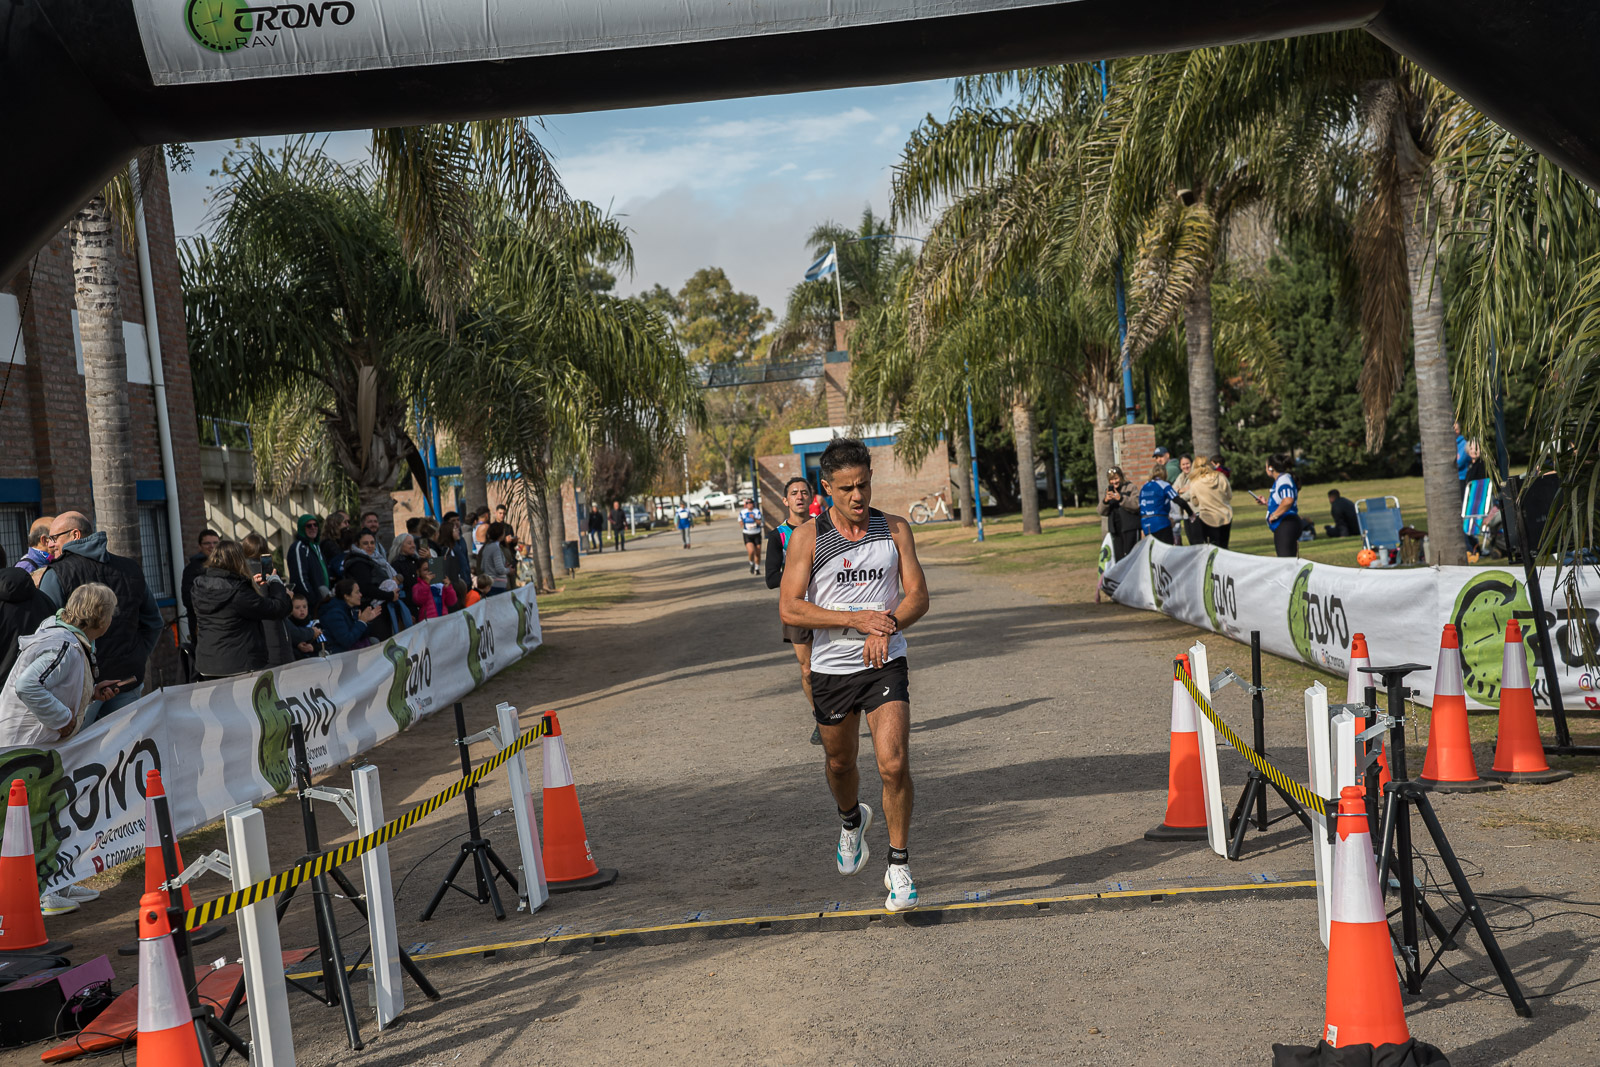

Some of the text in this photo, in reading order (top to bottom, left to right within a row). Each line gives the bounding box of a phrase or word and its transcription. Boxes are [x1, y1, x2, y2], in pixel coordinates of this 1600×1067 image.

[234, 1, 355, 32] CRONO
[235, 35, 277, 48] RAV
[837, 568, 883, 582] ATENAS
